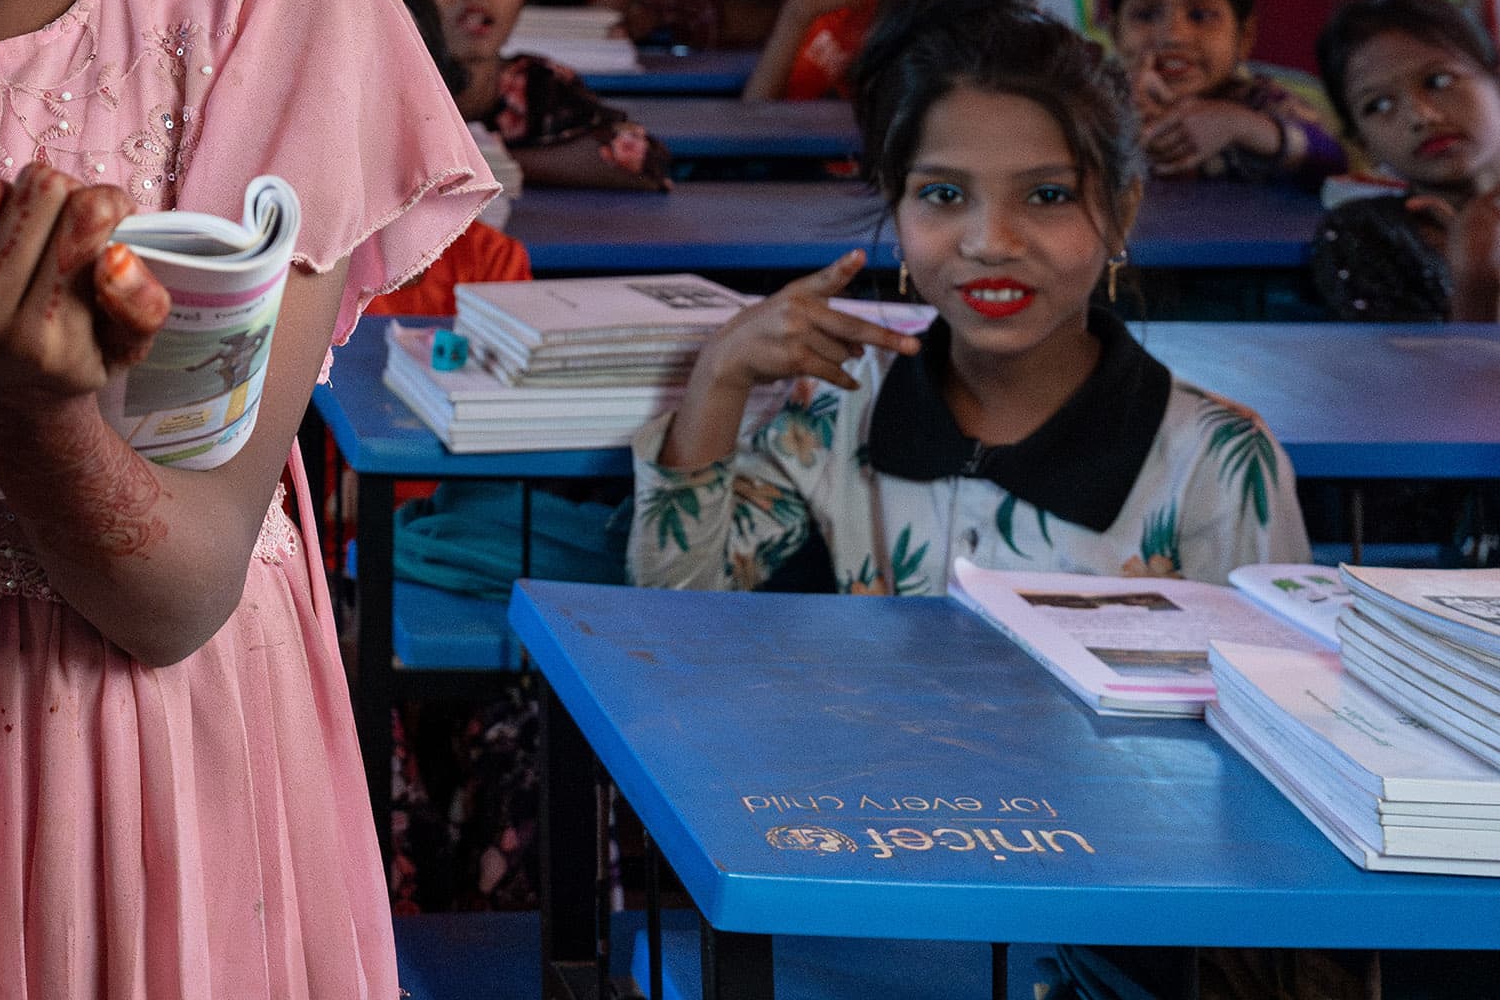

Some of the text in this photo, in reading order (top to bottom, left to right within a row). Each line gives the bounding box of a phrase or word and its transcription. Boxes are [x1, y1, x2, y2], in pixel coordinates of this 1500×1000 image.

[740, 796, 1058, 818] for every child
[866, 827, 1097, 861] unicef
